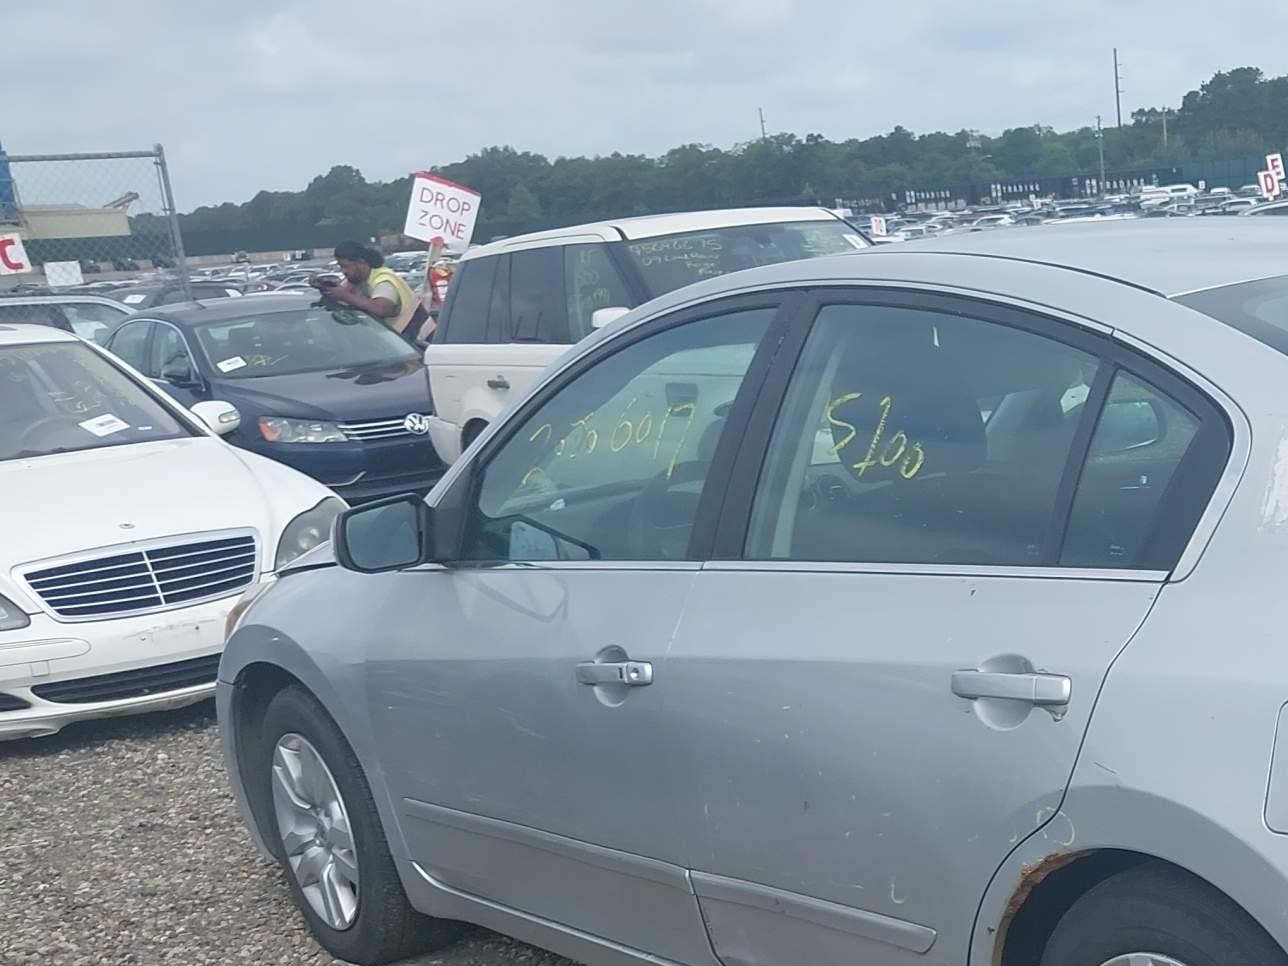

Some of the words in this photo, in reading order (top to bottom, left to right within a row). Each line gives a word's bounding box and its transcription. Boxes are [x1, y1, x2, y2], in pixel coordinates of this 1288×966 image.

[1263, 174, 1275, 192] D
[420, 187, 472, 216] DROP
[418, 209, 467, 240] ZONE
[0, 238, 25, 270] C
